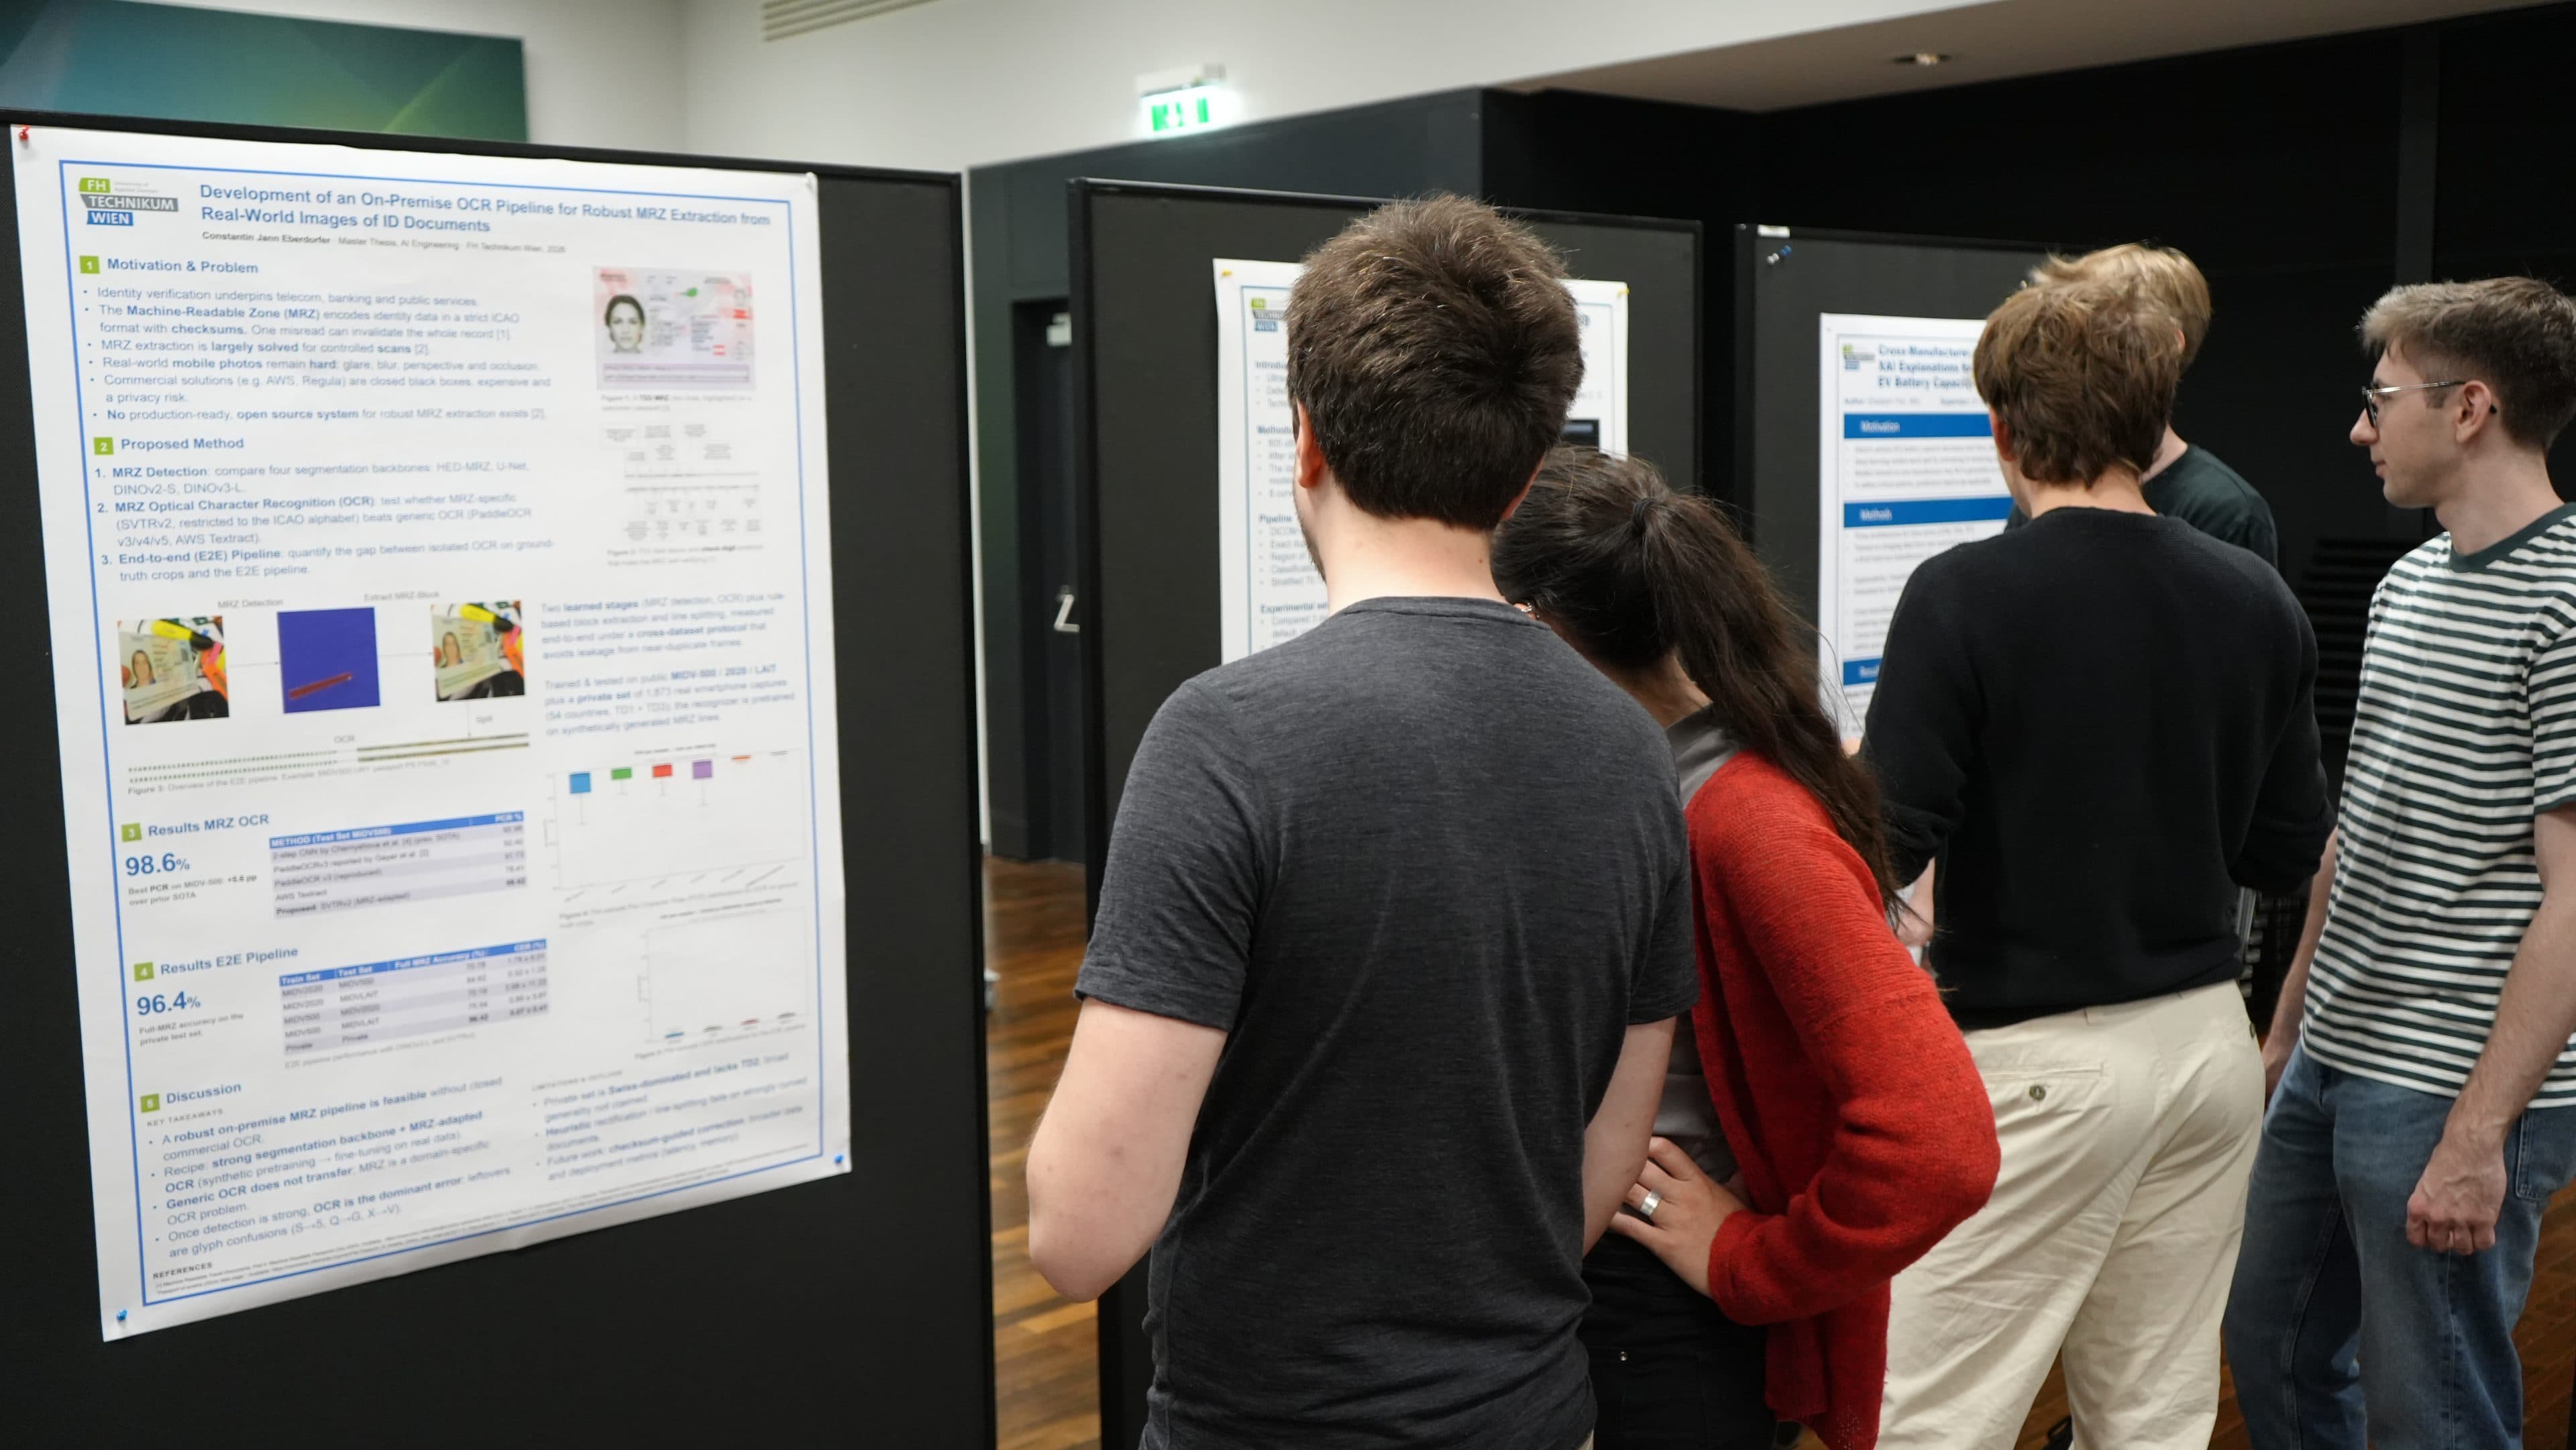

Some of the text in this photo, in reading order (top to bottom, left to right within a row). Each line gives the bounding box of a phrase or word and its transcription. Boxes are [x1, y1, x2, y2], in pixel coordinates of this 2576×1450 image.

[87, 180, 107, 191] FH
[88, 195, 174, 210] TECHNIKUM
[200, 185, 770, 225] Development of an On-Premise OCR Pipeline for Robust MRZ Extraction from
[91, 212, 129, 224] WIEN
[201, 207, 490, 231] Real-World Images of ID Documents
[201, 232, 254, 241] Constantin
[86, 260, 258, 272] 1 Motivation & Problem
[97, 287, 142, 301] Identity
[146, 289, 211, 299] verification
[215, 290, 273, 303] underpins
[99, 305, 370, 321] The Machine-Readable Zone (MRZ) encodes
[99, 322, 140, 333] format
[142, 323, 168, 333] with
[279, 325, 325, 335] misread
[101, 340, 411, 354] MRZ extraction largely solved controlled scans
[103, 357, 168, 368] Real-world
[172, 358, 215, 368] mobile
[219, 358, 262, 371] photos
[266, 358, 306, 368] remain
[103, 375, 233, 385] Commercial solutions
[117, 392, 160, 405] privacy
[236, 411, 268, 421] open
[271, 411, 313, 419] source
[316, 409, 359, 421] system
[101, 437, 244, 452] 2 Proposed Method
[112, 468, 142, 478] MRZ
[214, 467, 266, 478] compare
[268, 465, 290, 475] four
[115, 502, 145, 512] MRZ
[148, 500, 194, 513] Optical
[198, 499, 259, 510] Character
[262, 497, 335, 510] Recognition
[179, 516, 233, 528] restricted
[273, 514, 305, 525] ICAO
[119, 552, 191, 564] End-to-end
[194, 550, 227, 564] (E2E)
[151, 571, 184, 582] crops
[148, 821, 200, 836] Results
[204, 817, 234, 831] MRZ
[238, 813, 268, 827] OCR
[271, 836, 309, 847] METHOD
[125, 851, 189, 876] 98.6%
[140, 947, 298, 977] 4 Results E2E Pipeline
[137, 990, 200, 1015] 96.4%
[166, 1084, 241, 1104] Discussion
[174, 1090, 427, 1143] robust on-premise MRZ pipeline feasible
[162, 1140, 229, 1161] commercial
[212, 1153, 252, 1168] strong
[255, 1138, 336, 1161] segmentation
[339, 1127, 396, 1145] backbone
[165, 1158, 315, 1192] OCR (synthetic pretraining
[166, 1174, 303, 1209] Generic OCR does not
[166, 1211, 196, 1225] OCR
[168, 1228, 199, 1241] Once
[203, 1217, 255, 1235] detection
[313, 1198, 341, 1213] OCR
[378, 1182, 432, 1201] dominant
[191, 1227, 288, 1256] glyph confusions
